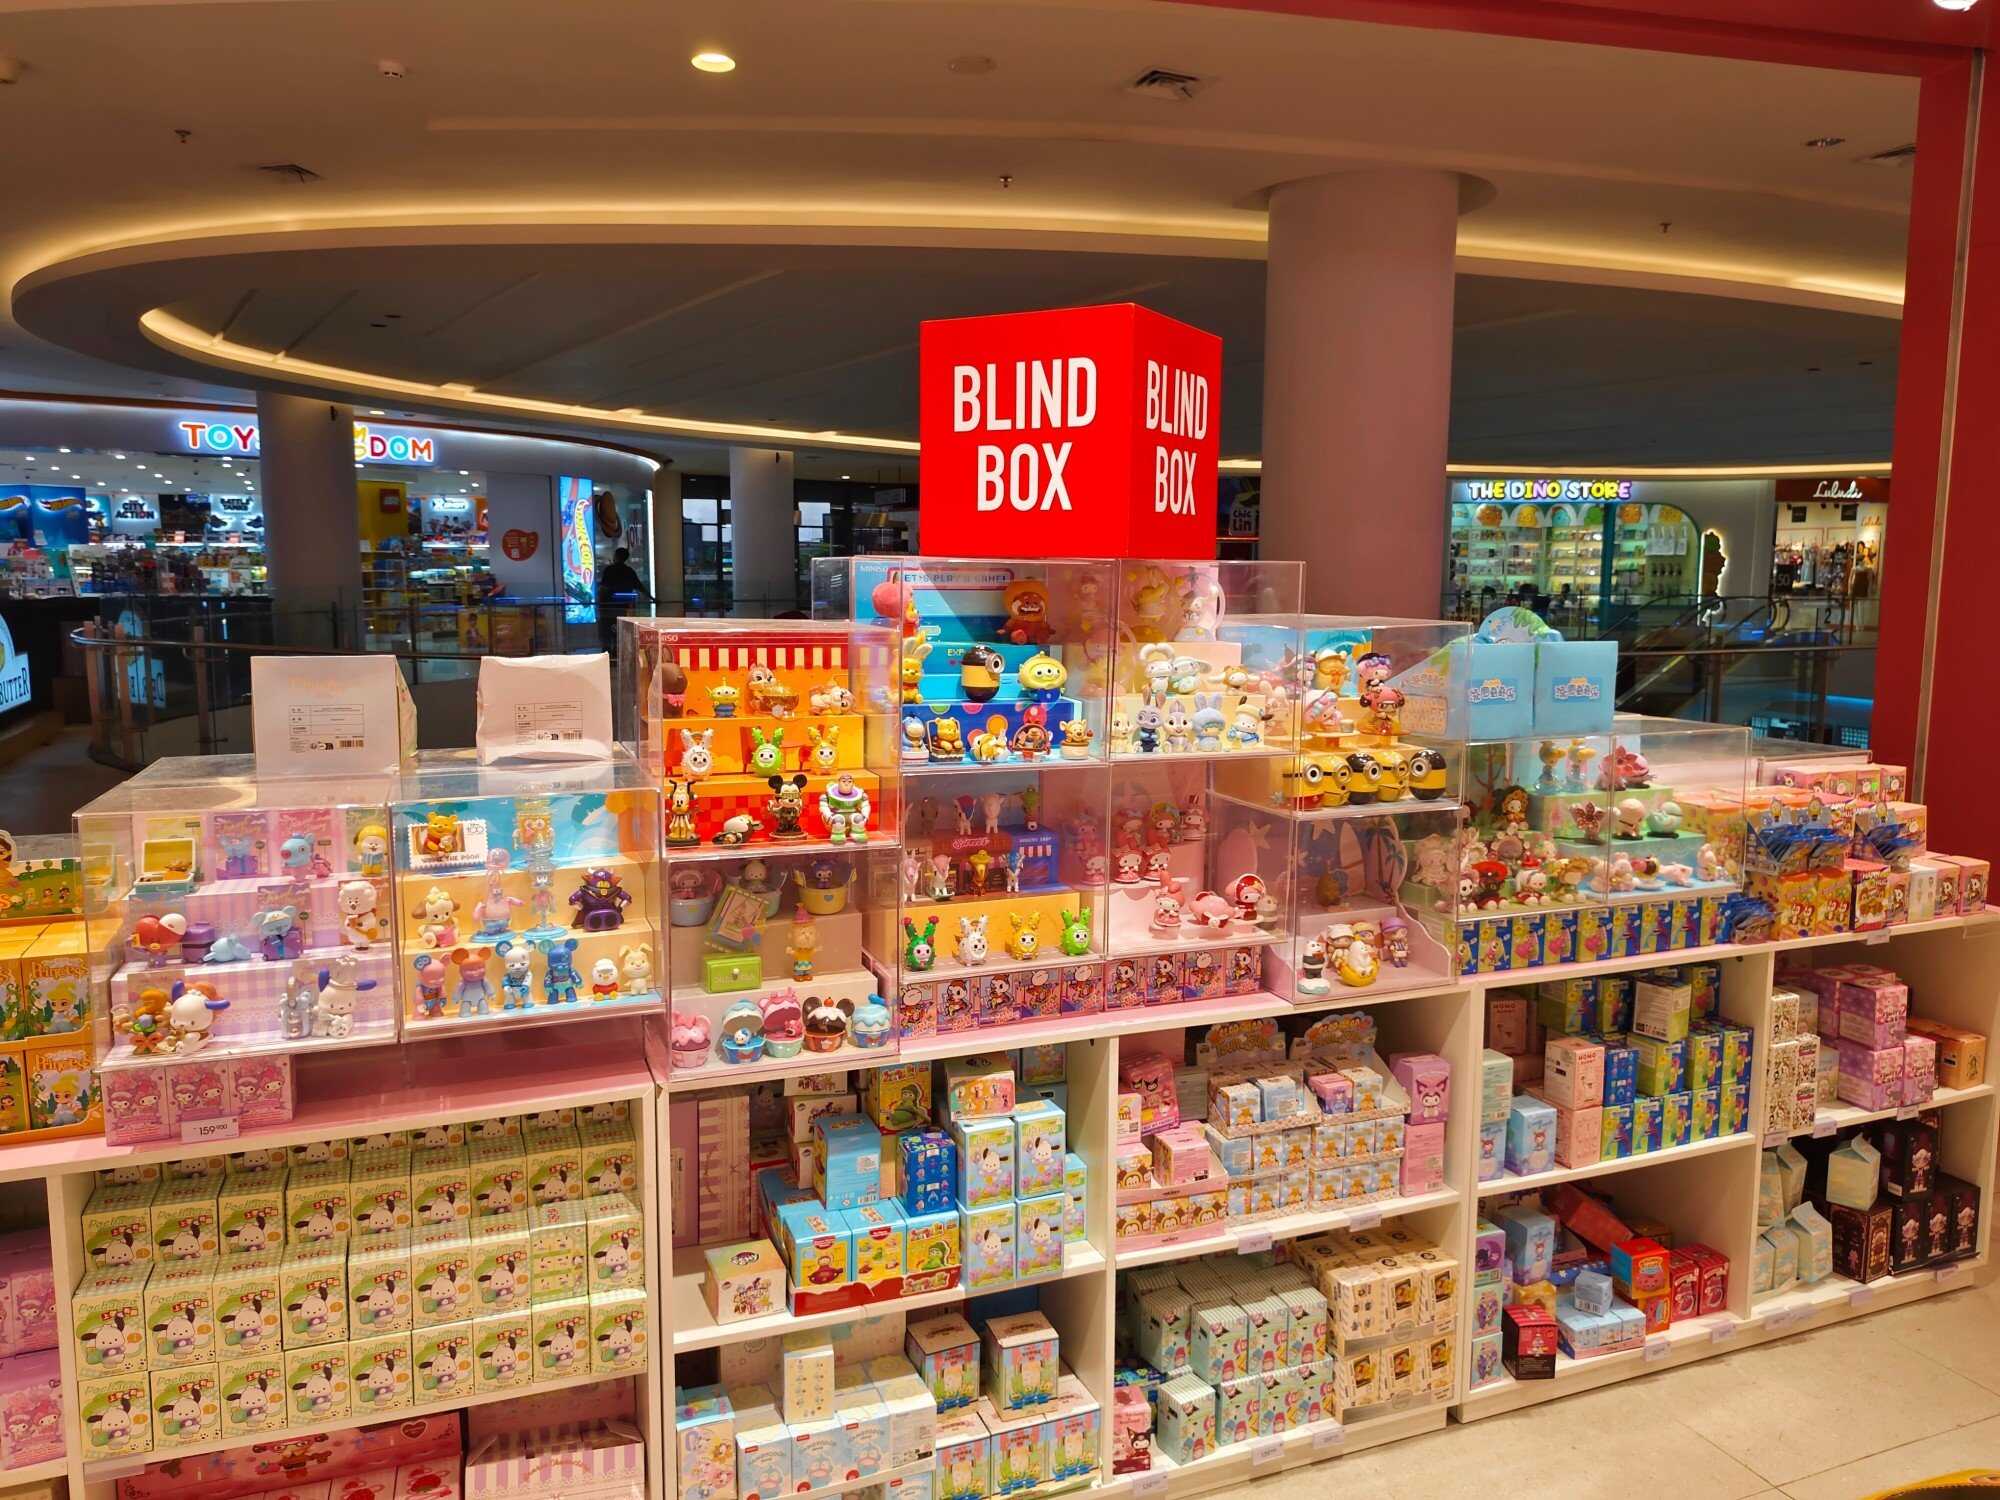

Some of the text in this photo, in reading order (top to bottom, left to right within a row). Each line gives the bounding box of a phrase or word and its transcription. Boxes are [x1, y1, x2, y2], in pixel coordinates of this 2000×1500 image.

[953, 356, 1097, 432] BLIND
[1146, 359, 1209, 440] BLIND
[181, 422, 261, 450] TOY
[977, 441, 1073, 512] BOX
[1155, 445, 1197, 515] BOX
[1469, 480, 1632, 499] THE DINO STORE
[115, 511, 155, 519] ACTION
[122, 502, 144, 511] CITY
[1823, 608, 1833, 624] 2
[199, 1125, 216, 1136] 159
